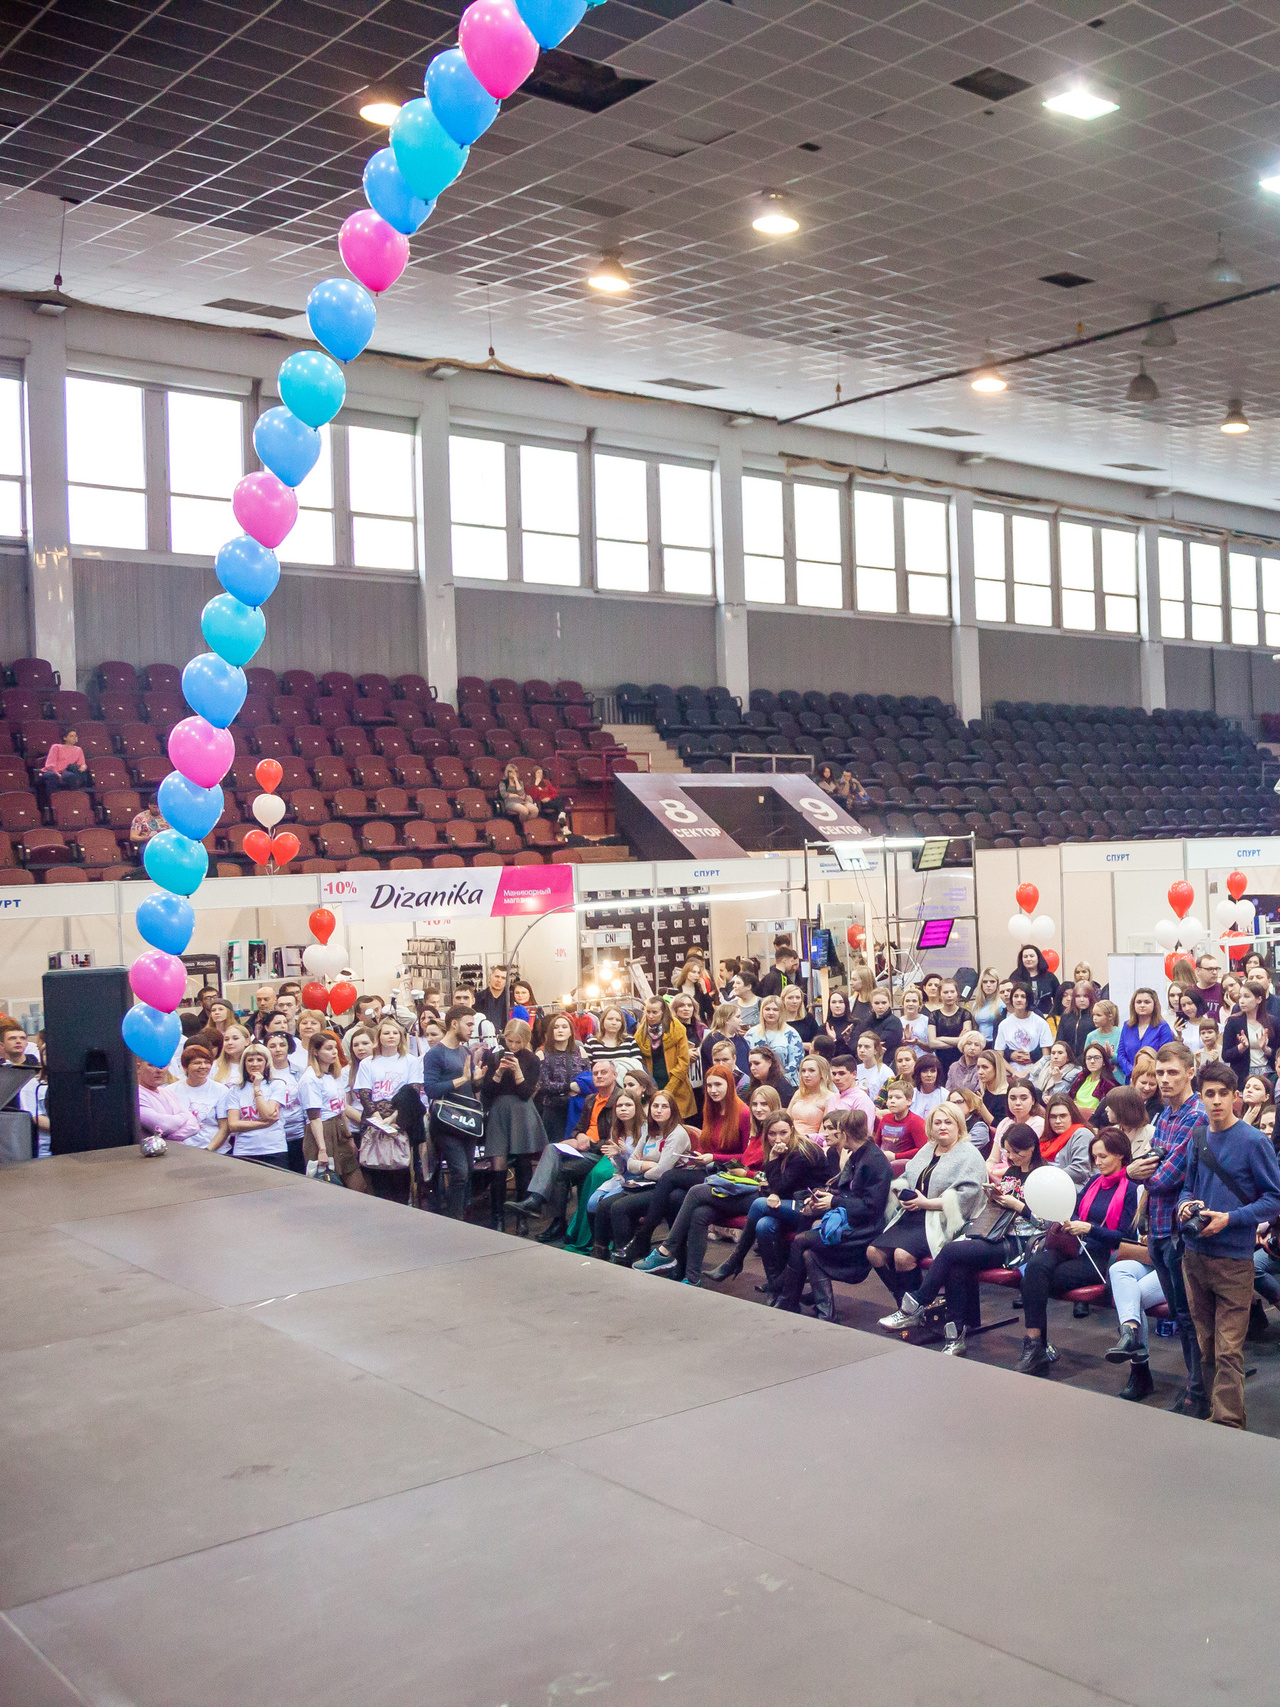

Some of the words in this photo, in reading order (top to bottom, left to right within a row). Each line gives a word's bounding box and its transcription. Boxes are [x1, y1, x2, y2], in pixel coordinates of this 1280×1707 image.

[659, 799, 698, 824] 8
[799, 797, 839, 822] 9
[672, 827, 722, 839] СЕКТОР
[818, 825, 863, 836] СЕКТОР
[1106, 854, 1130, 862] СПУРТ
[1236, 849, 1261, 858] СПУРТ
[323, 881, 357, 895] -10%
[370, 881, 484, 910] Dizanika
[605, 933, 616, 944] CNI
[451, 1113, 476, 1128] FILA
